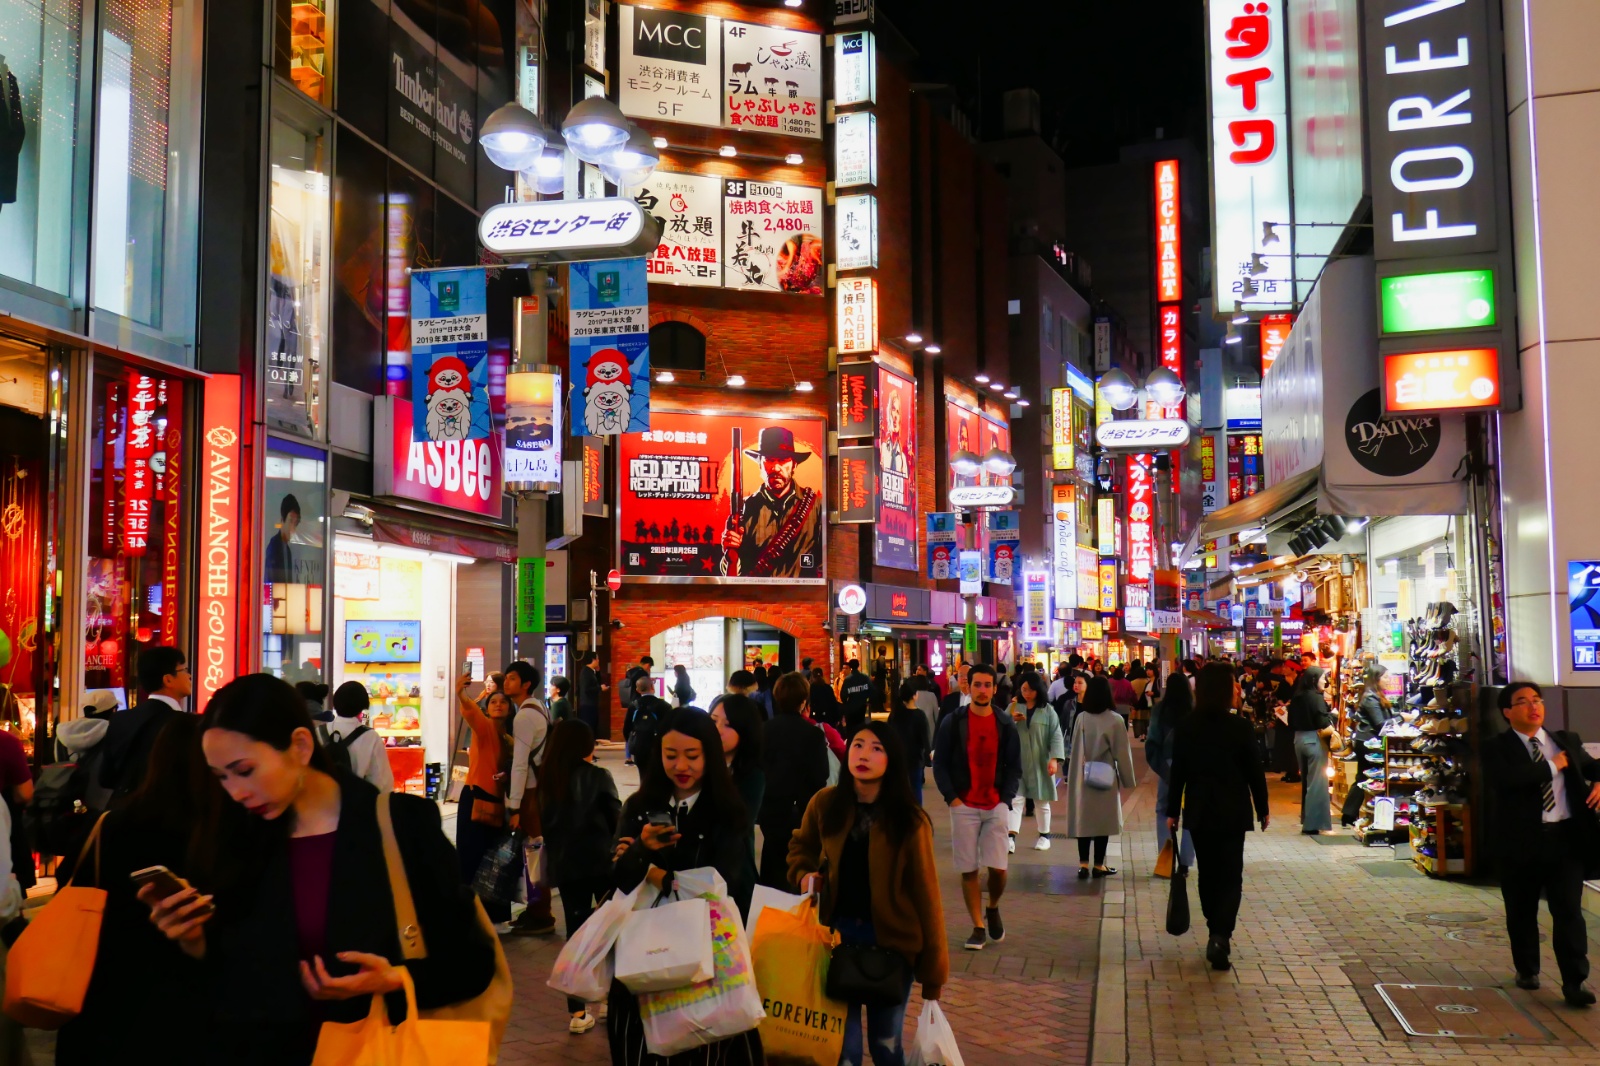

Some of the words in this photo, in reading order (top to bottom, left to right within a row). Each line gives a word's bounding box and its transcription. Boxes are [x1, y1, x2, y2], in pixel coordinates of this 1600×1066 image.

[638, 19, 702, 49] MCC
[729, 26, 747, 39] 4F
[843, 39, 862, 50] MCC
[639, 64, 701, 85] 渋谷消費者
[1225, 2, 1275, 164] ダイワ
[393, 52, 457, 135] Timberland
[627, 77, 713, 101] モニタールーム
[728, 78, 759, 96] ラム
[768, 87, 777, 97] 牛
[788, 89, 798, 98] 豚
[657, 101, 684, 117] 5F
[729, 95, 817, 116] しゃぶしゃぶ
[399, 105, 415, 125] BEST
[730, 113, 779, 128] 食べ放題
[838, 116, 850, 124] 4F
[727, 181, 744, 195] 3F
[729, 199, 814, 215] 焼肉食べ放題
[858, 198, 867, 206] 3F
[488, 211, 632, 239] 渋谷センター街
[697, 265, 717, 278] 2F
[853, 281, 870, 291] 2F
[417, 316, 482, 328] ラグビーワールドカップ
[575, 308, 643, 319] ラグビーワールドカップ
[849, 376, 866, 424] Wendy's
[841, 394, 849, 428] Kitchen
[1100, 426, 1184, 440] 渋谷センター街
[515, 439, 551, 449] SASEBO
[406, 427, 492, 500] ASBee
[630, 459, 659, 478] RED
[661, 460, 700, 480] DEAD
[630, 477, 700, 493] REDEMPTION
[849, 459, 870, 508] Wendy's
[842, 478, 850, 512] Kitchen
[1057, 489, 1071, 498] B1
[207, 450, 231, 597] AVALANCHE
[1102, 586, 1113, 607] 松屋
[1577, 647, 1593, 663] 7F
[763, 998, 829, 1031] FOREVER
[830, 1014, 843, 1035] 21
